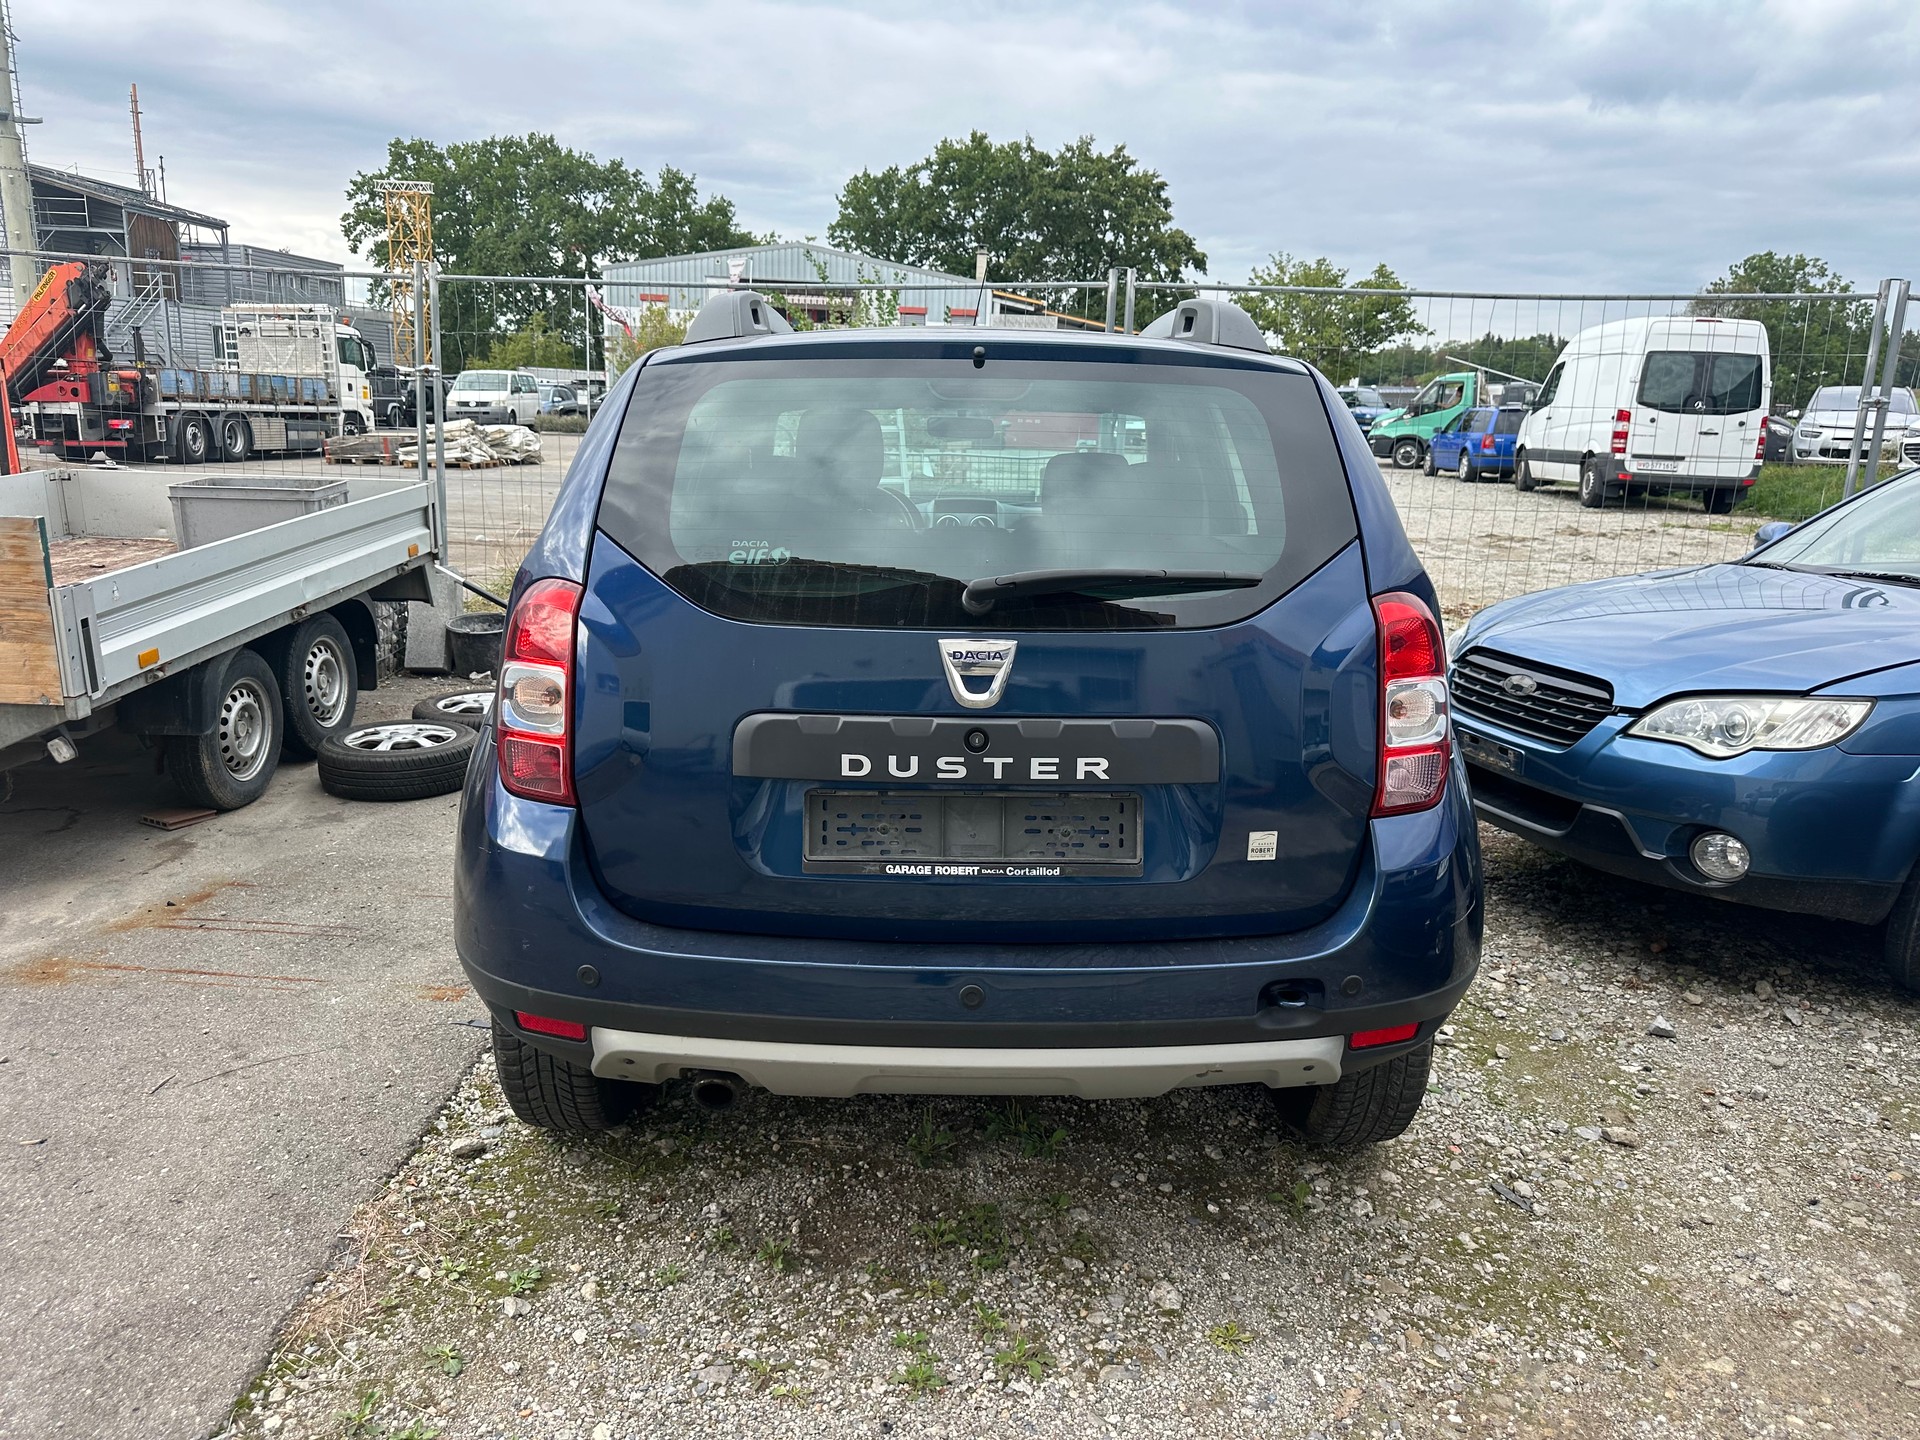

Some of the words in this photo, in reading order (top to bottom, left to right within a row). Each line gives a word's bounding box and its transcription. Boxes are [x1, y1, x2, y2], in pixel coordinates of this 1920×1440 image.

[34, 271, 56, 300] PALFINGER
[728, 548, 769, 565] elf
[952, 651, 1004, 660] DACIA
[841, 754, 1110, 780] DUSTER
[886, 864, 932, 874] GARAGE
[935, 866, 980, 876] ROBERT
[1006, 866, 1060, 876] Cortaillod
